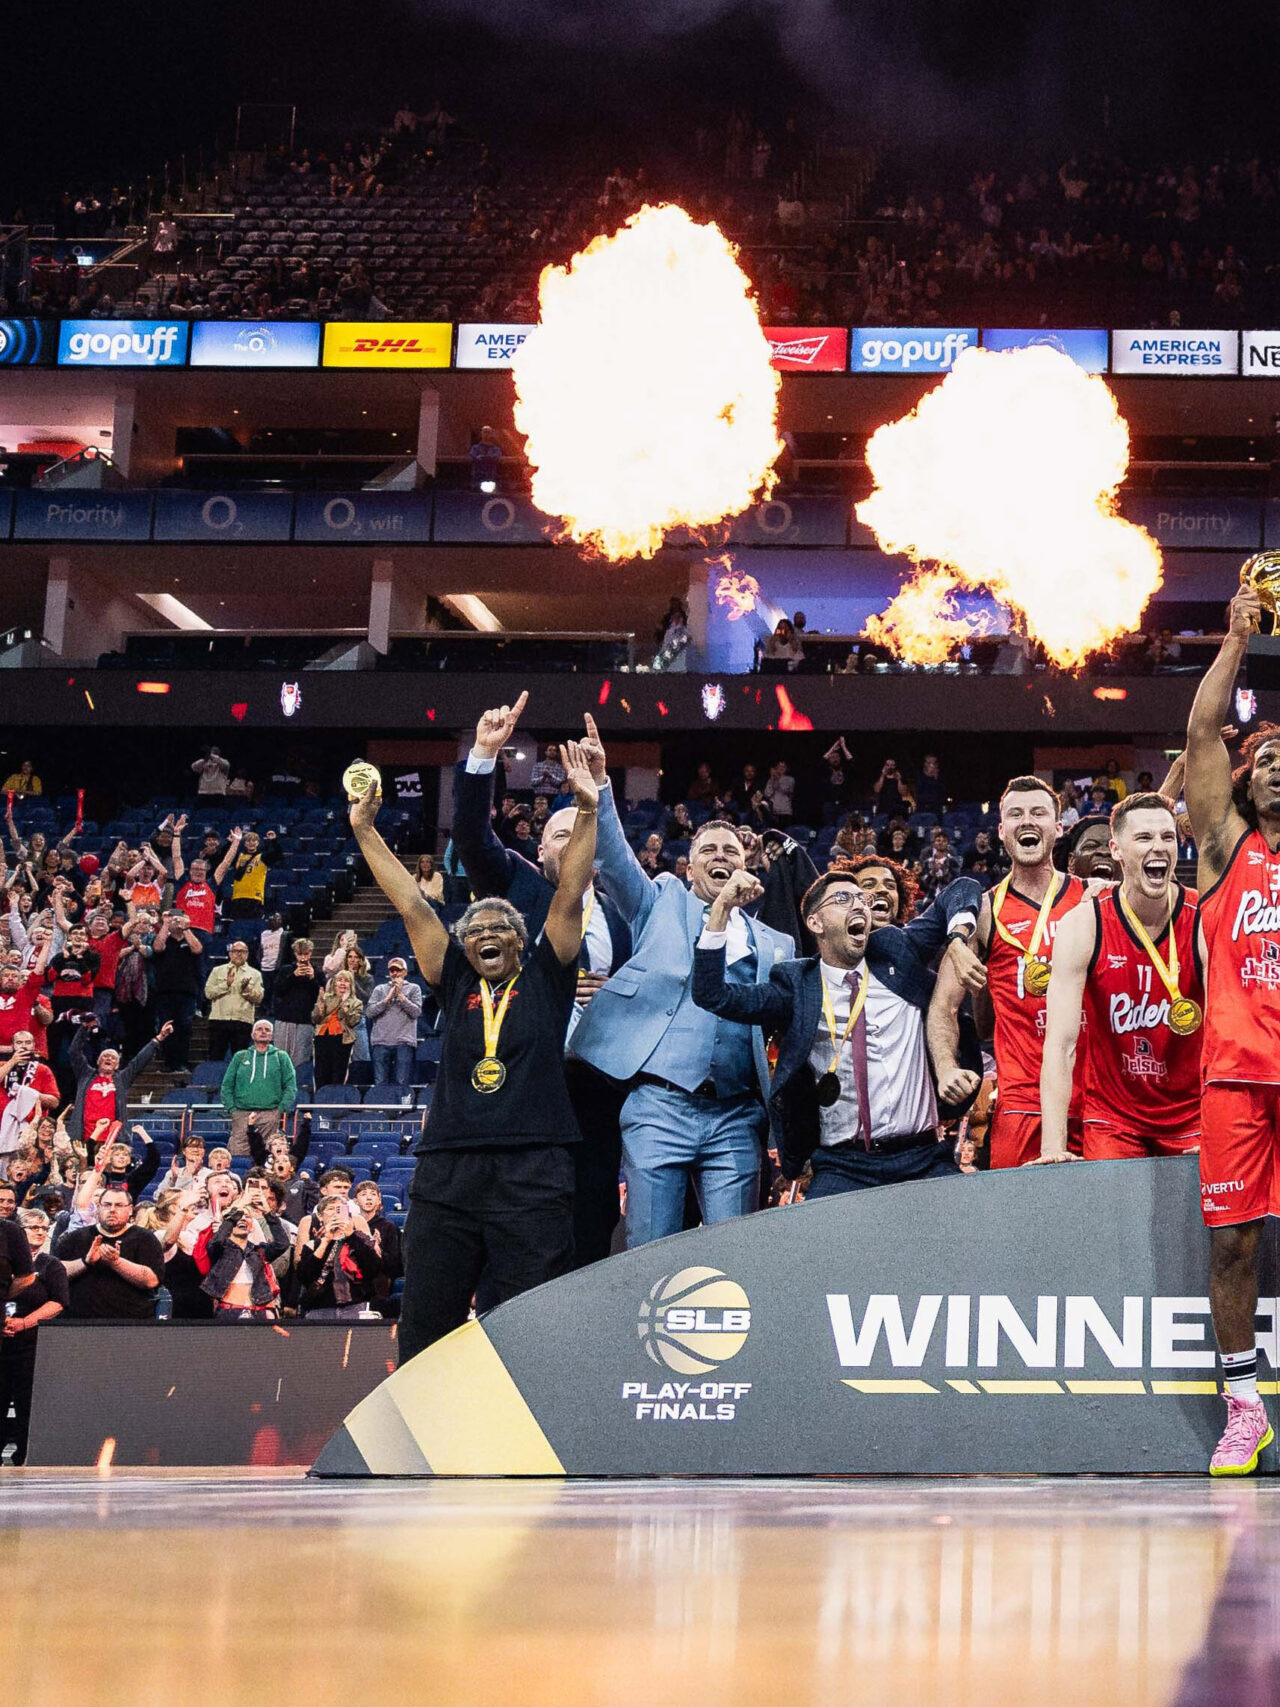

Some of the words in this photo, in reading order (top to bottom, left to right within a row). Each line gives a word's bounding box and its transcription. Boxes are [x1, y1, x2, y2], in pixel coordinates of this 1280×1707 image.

[69, 327, 178, 361] gopuff
[353, 339, 423, 353] DHL
[475, 334, 525, 346] AMER
[1129, 340, 1221, 352] AMERICAN
[862, 334, 968, 367] gopuff
[1143, 353, 1222, 365] EXPRESS
[47, 503, 119, 527] Priority
[371, 514, 402, 531] wifi
[1157, 510, 1230, 535] Priority
[1110, 992, 1170, 1034] Rider
[1206, 1180, 1244, 1194] VERTU
[667, 1310, 751, 1331] SLB
[622, 1382, 752, 1399] PLAY-OFF
[636, 1403, 736, 1420] FINALS
